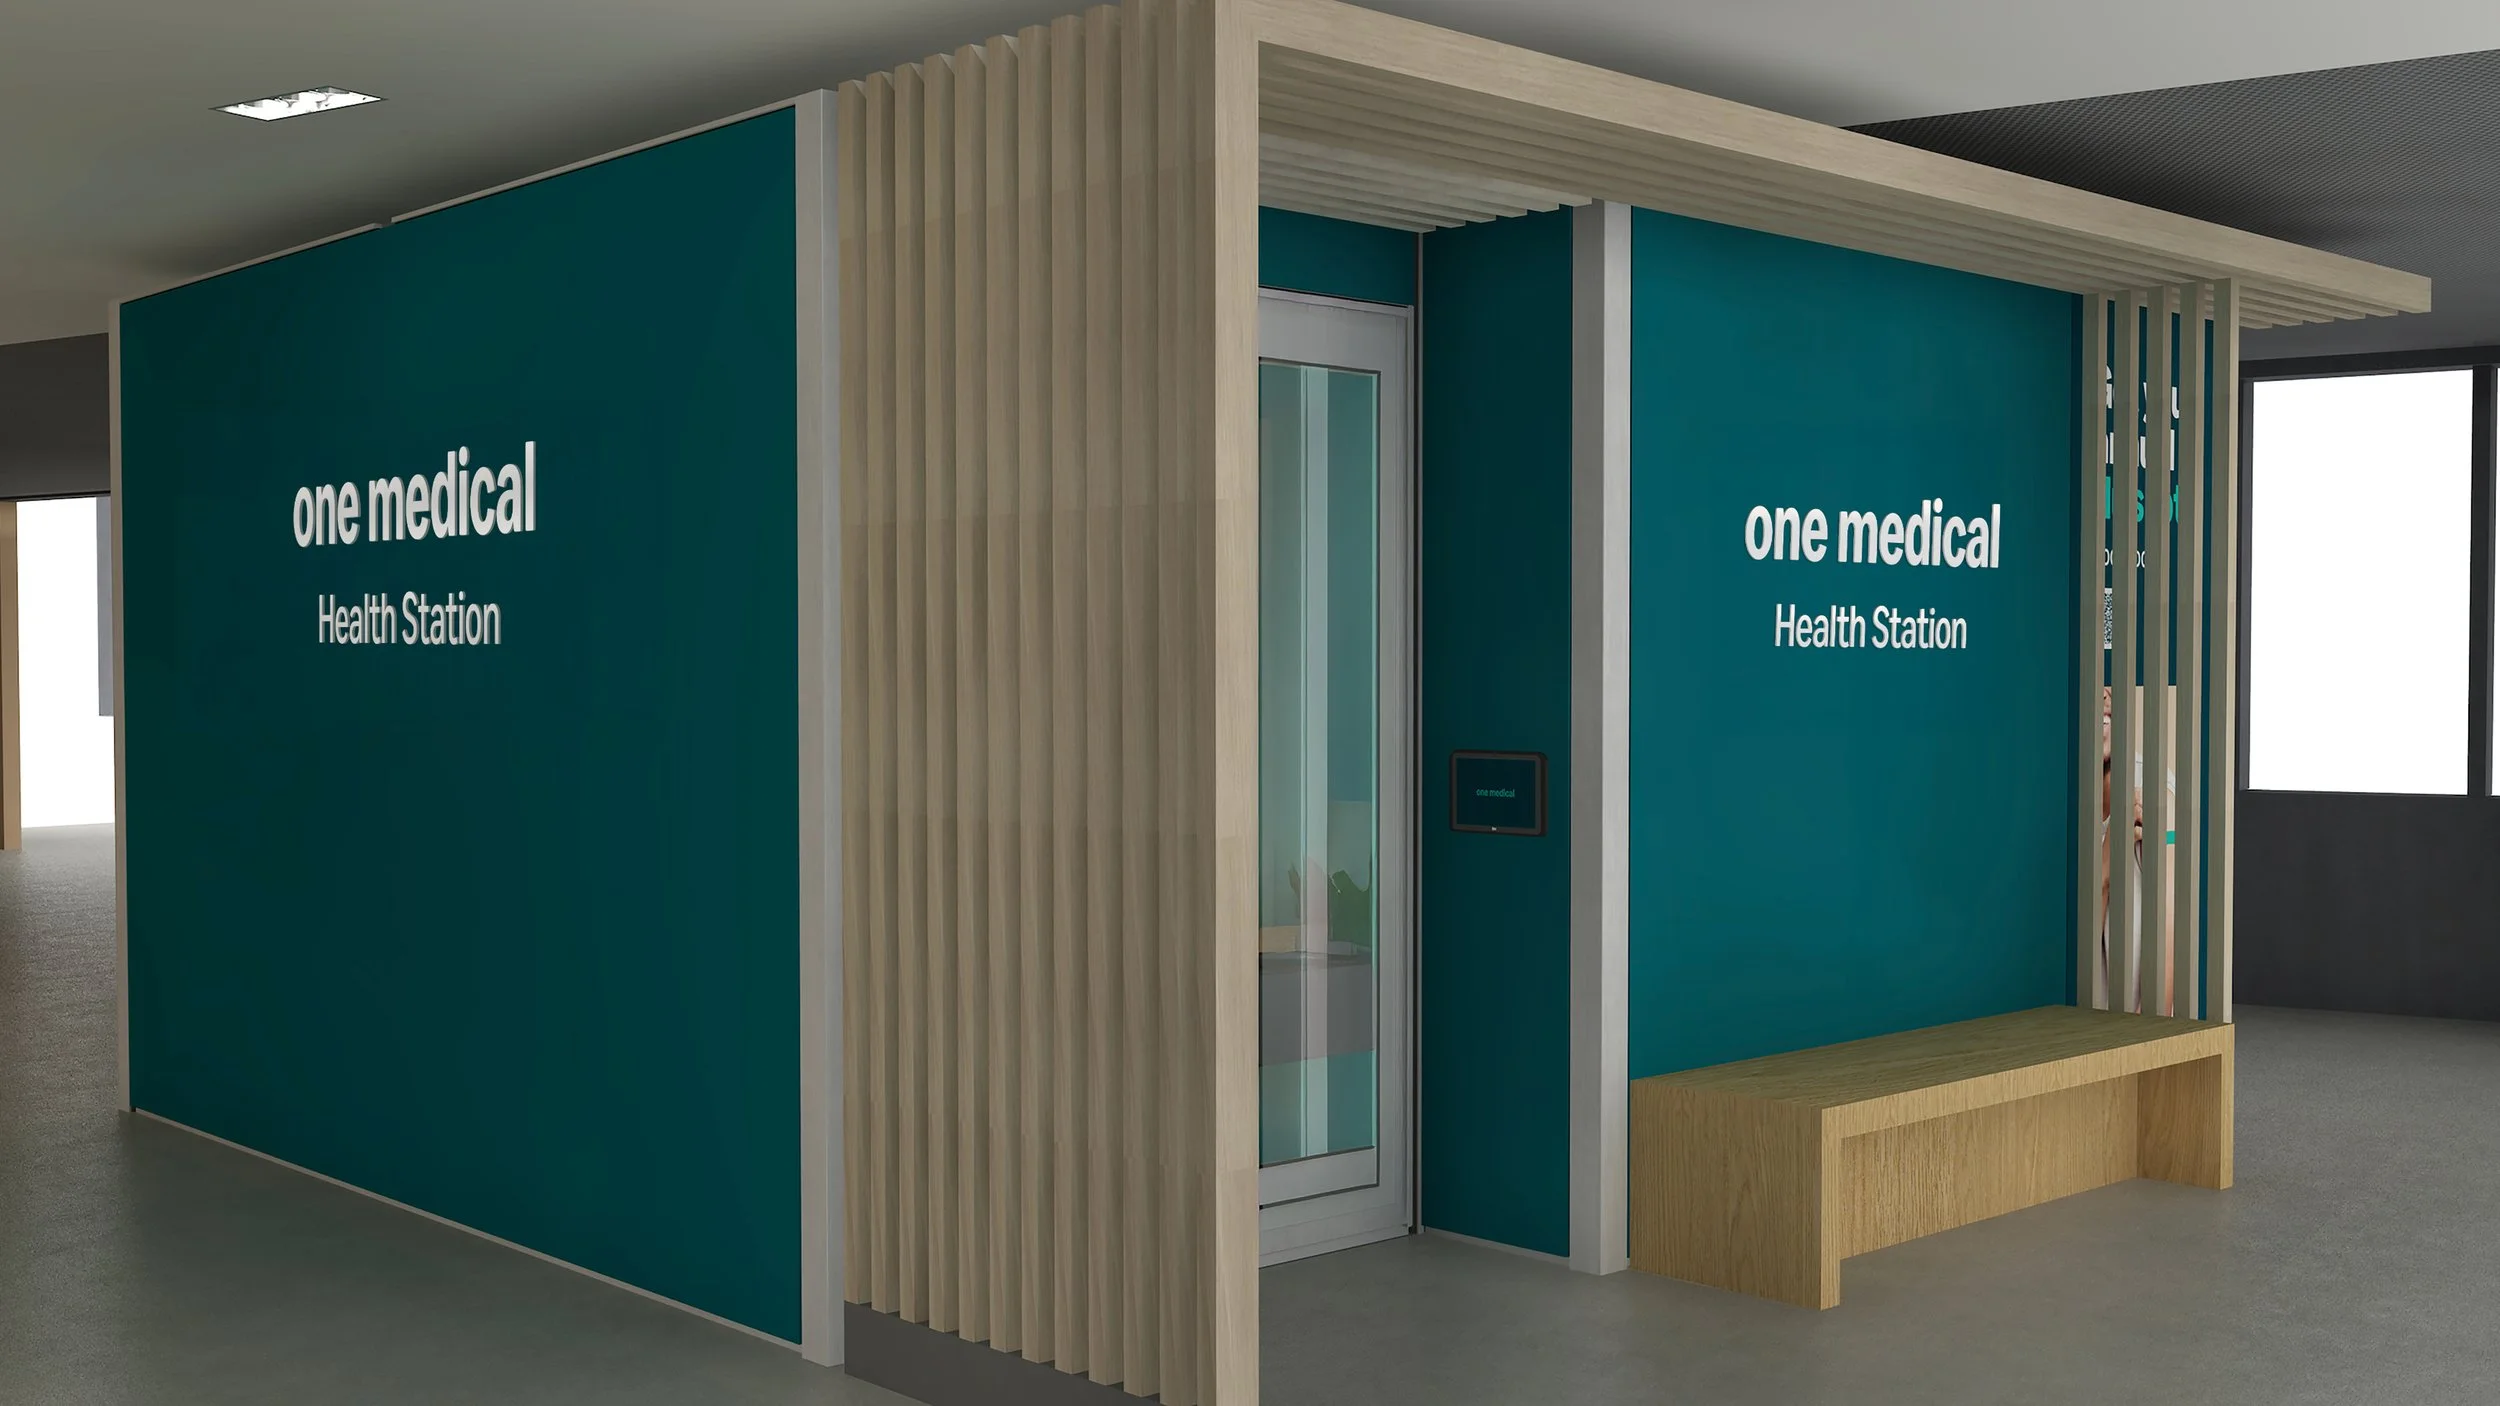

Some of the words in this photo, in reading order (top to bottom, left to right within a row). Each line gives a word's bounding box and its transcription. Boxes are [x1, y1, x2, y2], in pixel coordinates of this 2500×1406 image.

[293, 481, 360, 548] one
[368, 441, 536, 542] medical
[1744, 505, 1829, 564] one
[1837, 497, 2001, 569] medical
[318, 592, 396, 645] Health
[401, 590, 500, 646] Station
[1774, 603, 1866, 649] Health
[1871, 605, 1967, 649] Station
[1489, 788, 1515, 798] medical
